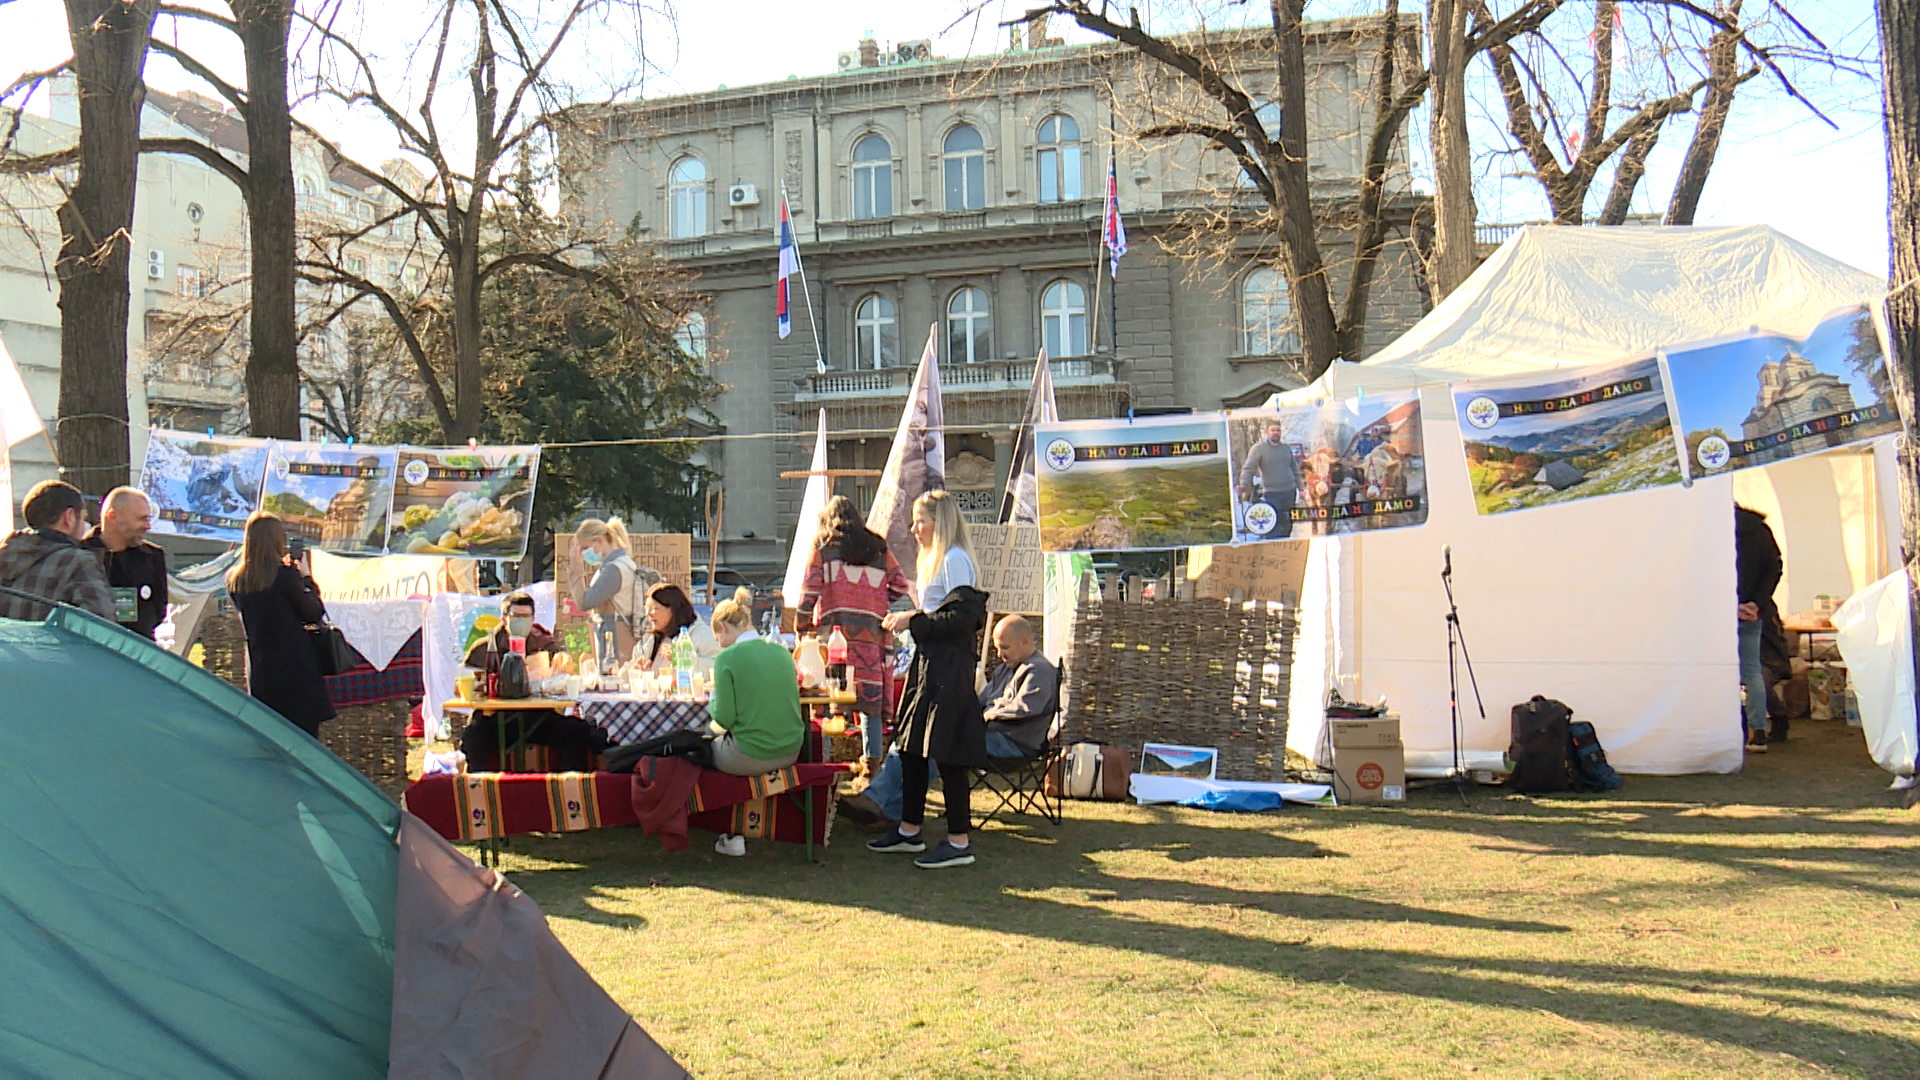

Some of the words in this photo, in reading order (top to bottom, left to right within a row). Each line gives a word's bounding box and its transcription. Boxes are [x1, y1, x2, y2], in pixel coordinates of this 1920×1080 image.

[1602, 380, 1644, 399] ДАМО
[1840, 406, 1881, 428] ДАМО
[1131, 444, 1149, 458] ДА
[1172, 440, 1211, 455] ДАМО
[1332, 503, 1349, 519] ДА
[1374, 498, 1415, 514] ДАМО
[971, 526, 1009, 546] НАШУ
